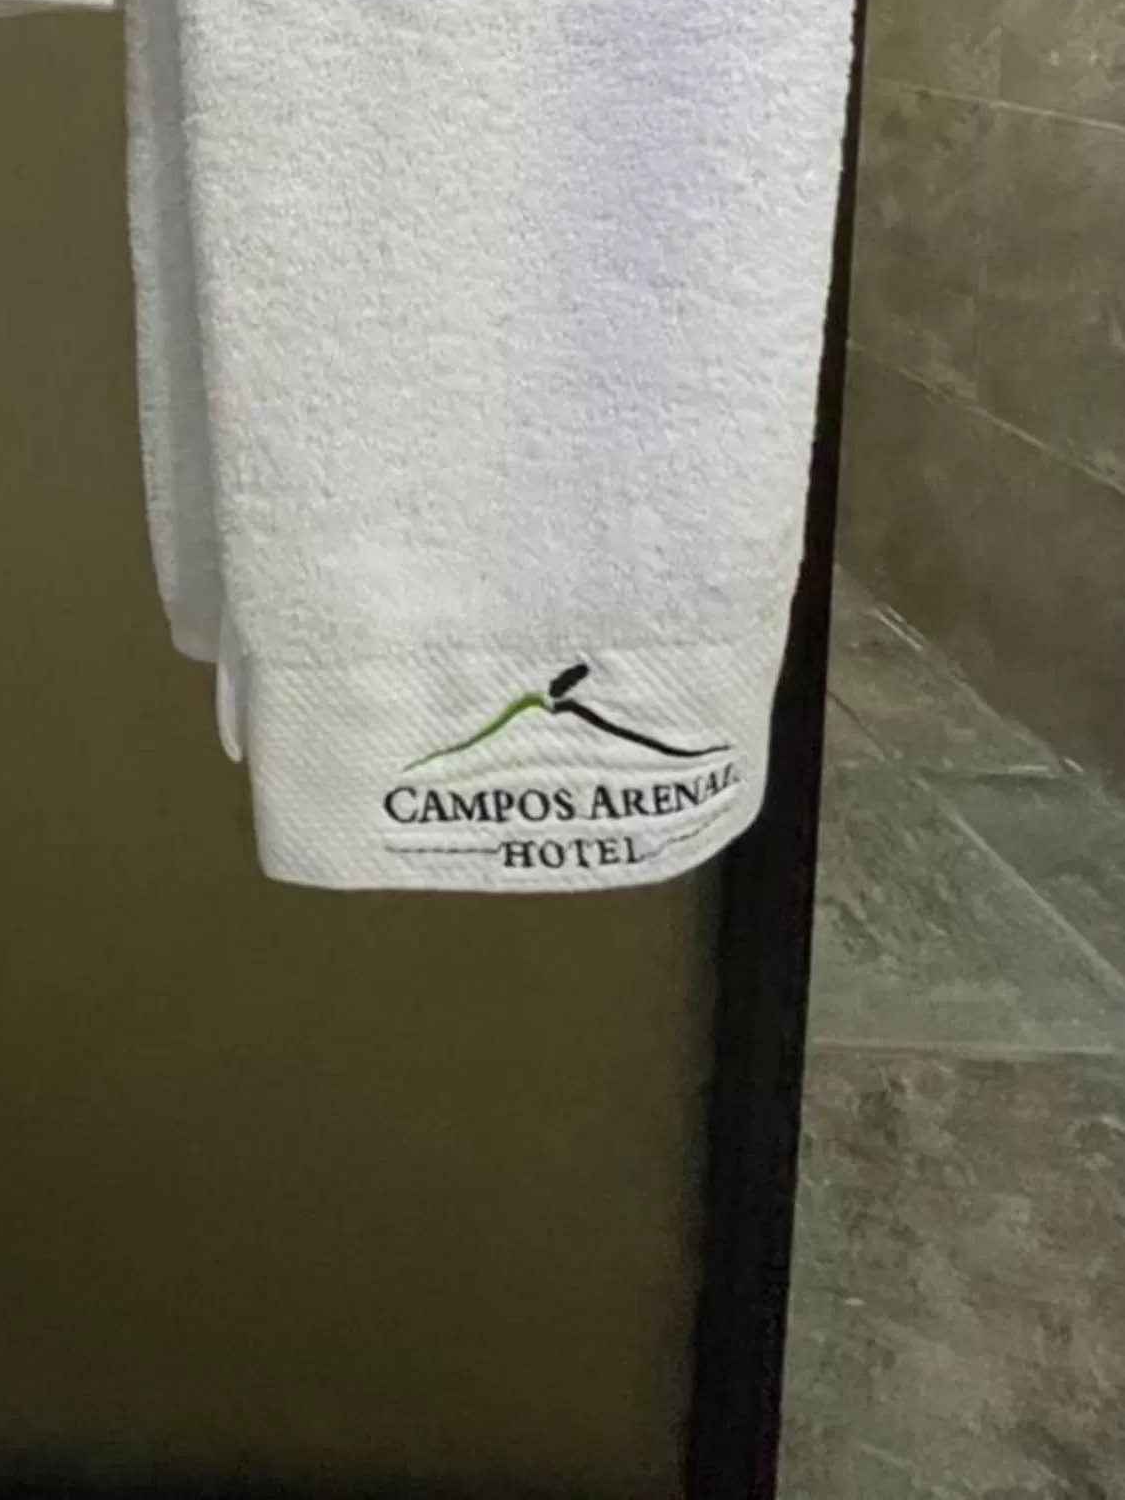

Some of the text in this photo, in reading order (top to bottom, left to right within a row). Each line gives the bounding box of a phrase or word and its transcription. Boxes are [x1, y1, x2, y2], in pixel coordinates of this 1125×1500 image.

[383, 762, 741, 823] CAMPOS ARENAL
[502, 837, 644, 869] HOTEL
